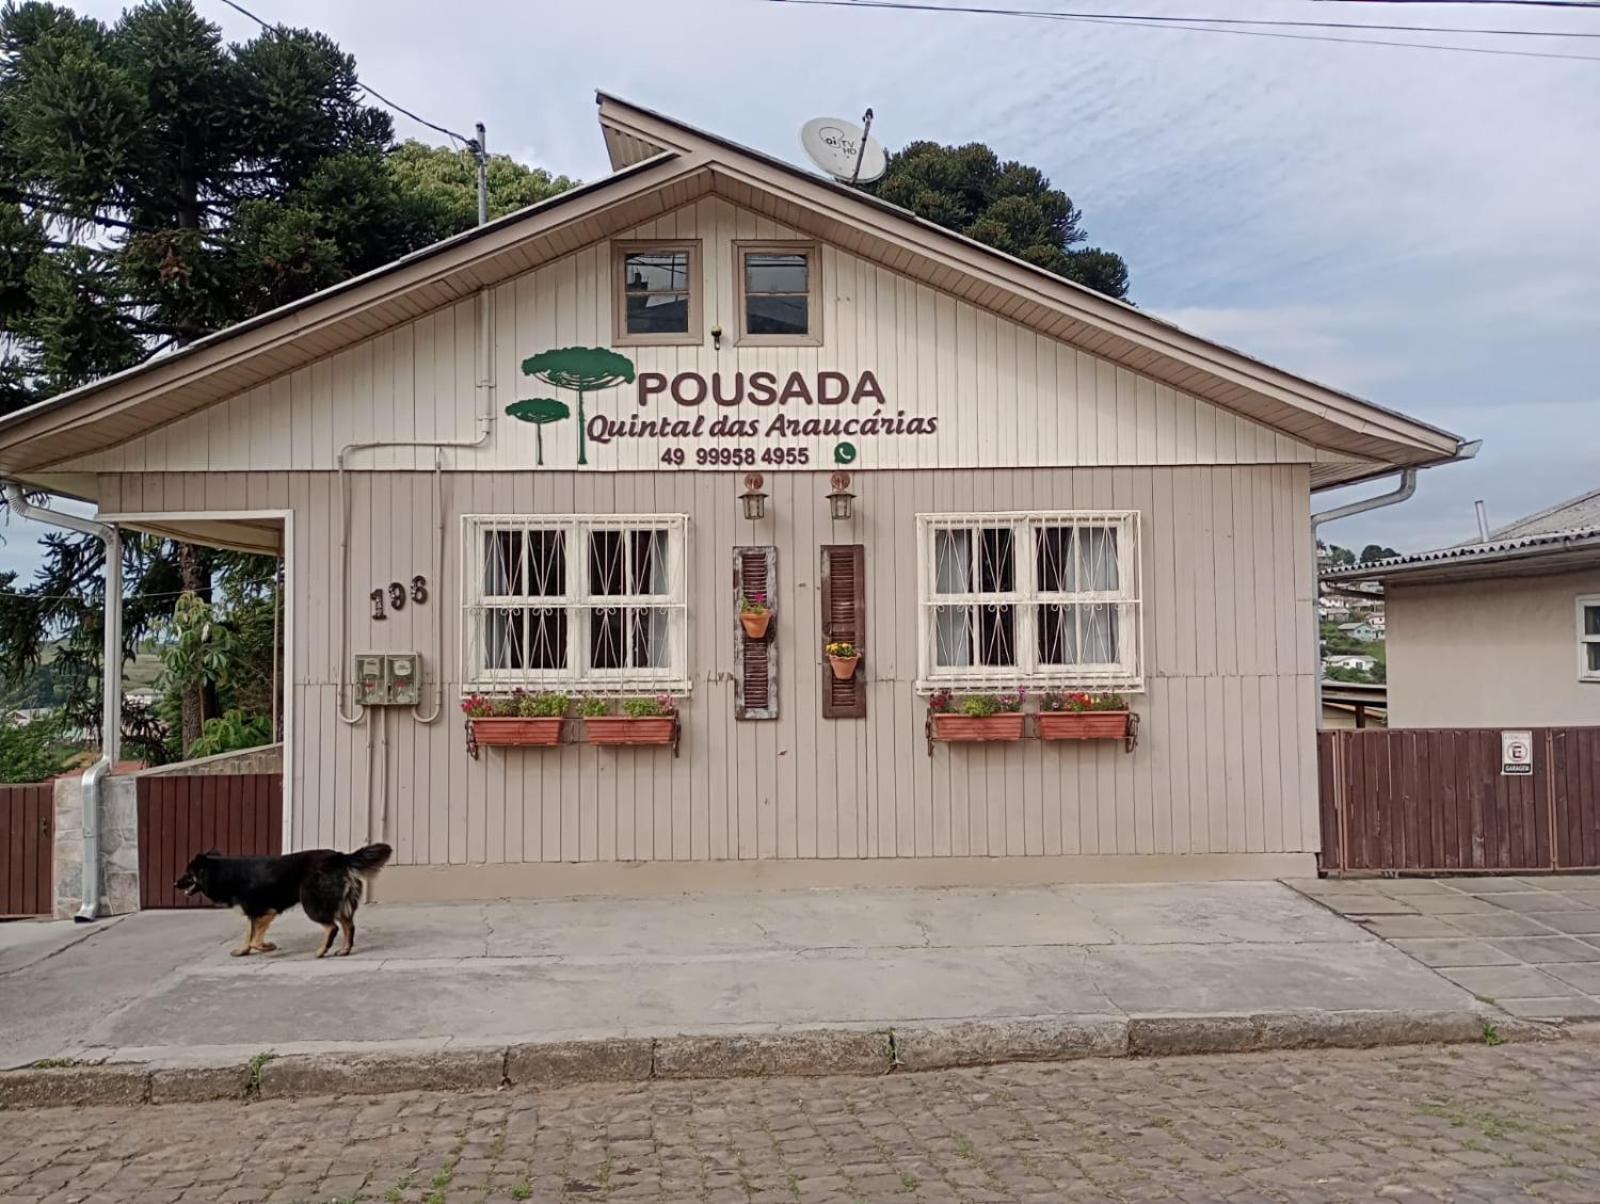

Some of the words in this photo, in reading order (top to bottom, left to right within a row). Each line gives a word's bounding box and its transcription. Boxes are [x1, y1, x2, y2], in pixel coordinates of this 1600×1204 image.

[841, 140, 855, 148] TV
[842, 147, 858, 155] HD
[638, 371, 886, 406] POUSADA
[586, 414, 705, 444] Quintal
[709, 415, 760, 438] das
[765, 408, 939, 438] Araucárias
[661, 448, 685, 465] 49
[696, 448, 756, 465] 99958
[761, 447, 810, 465] 4955
[370, 575, 428, 620] 196
[1512, 745, 1522, 759] E
